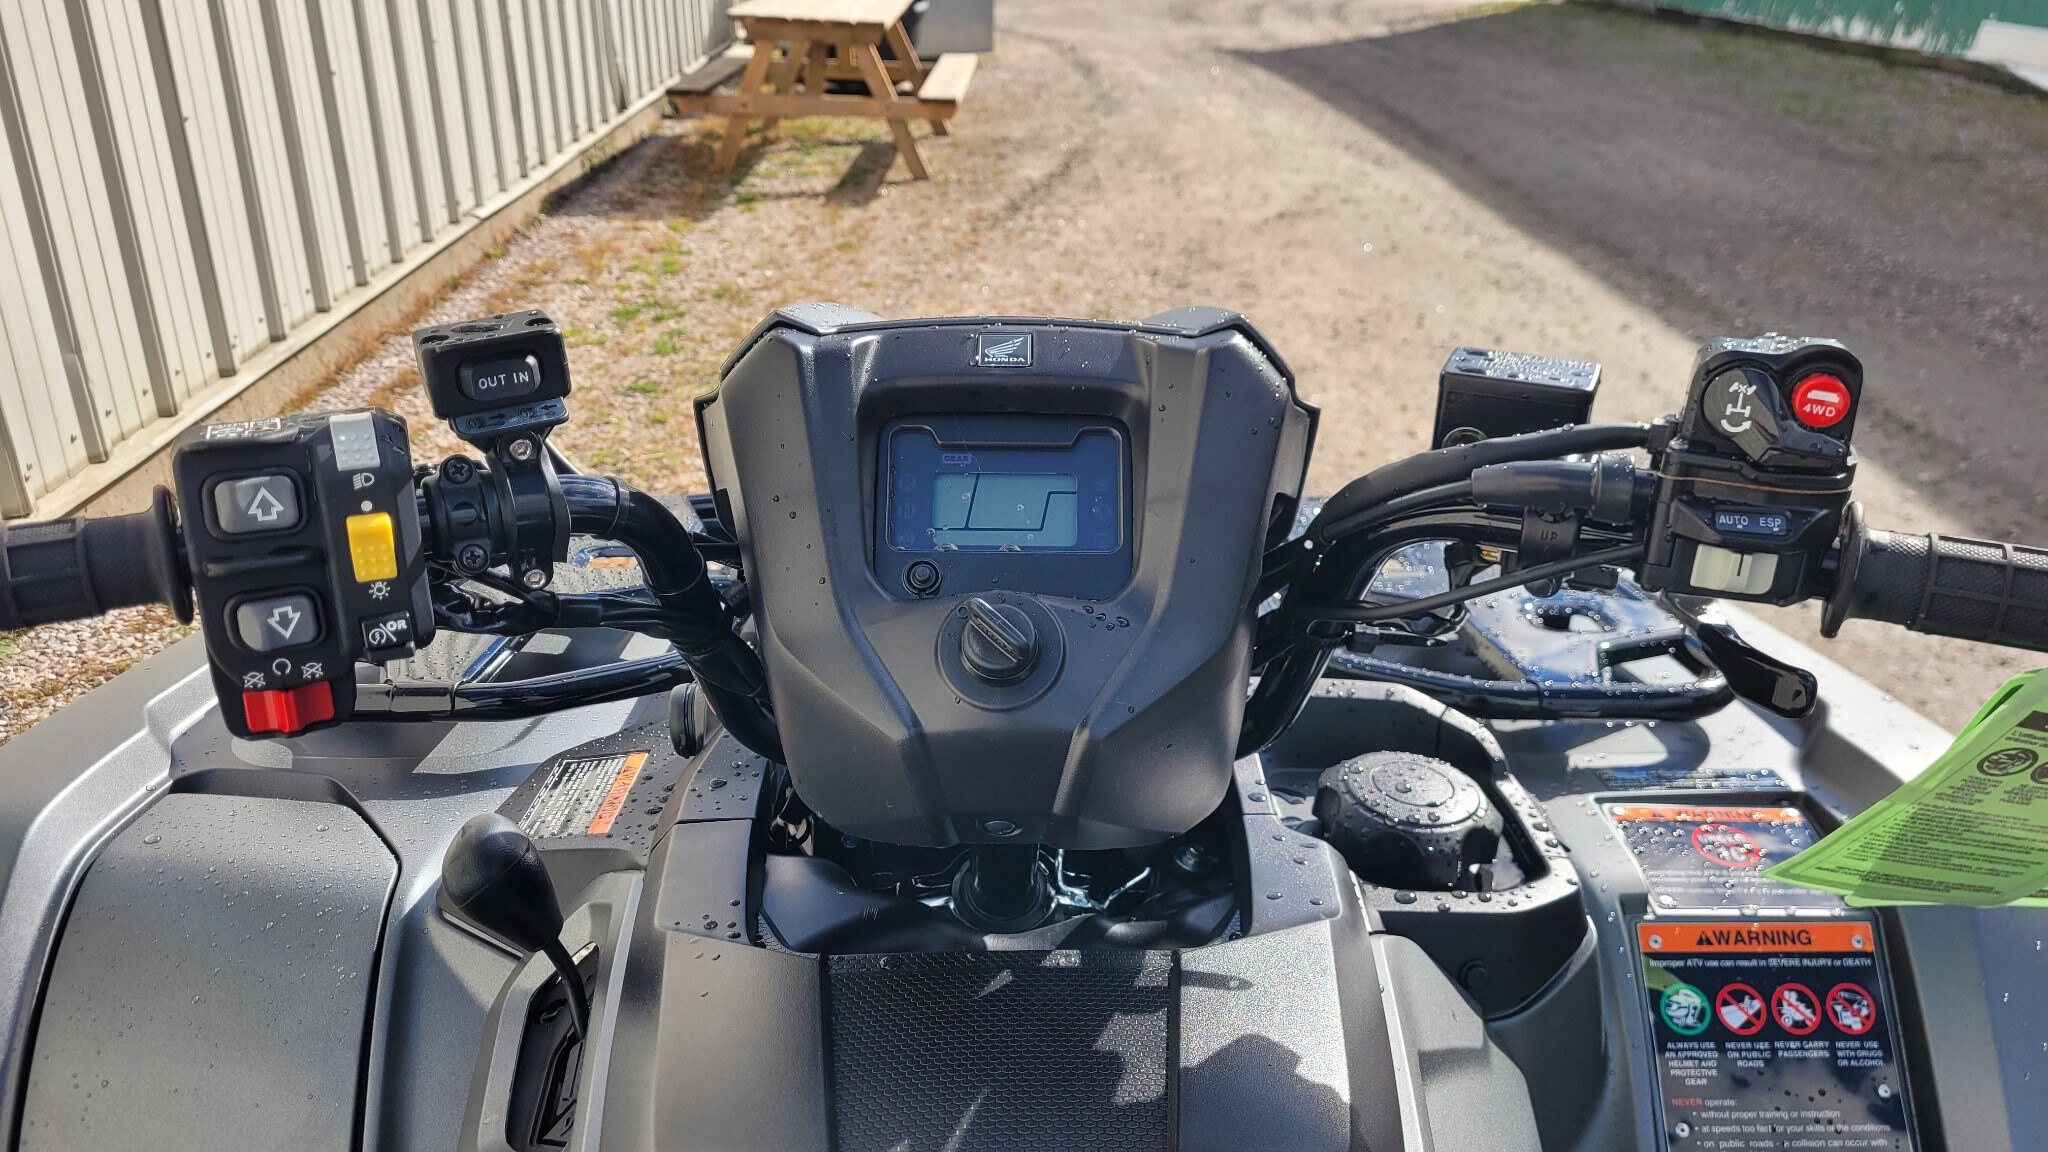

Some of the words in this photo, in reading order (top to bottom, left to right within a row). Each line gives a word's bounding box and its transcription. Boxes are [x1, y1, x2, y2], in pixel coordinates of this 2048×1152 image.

[478, 373, 506, 389] OUT
[513, 371, 529, 384] IN
[1803, 403, 1836, 417] 4WD
[1719, 514, 1749, 526] AUTO
[1759, 517, 1782, 528] ESP
[1541, 529, 1558, 541] UP
[386, 619, 407, 631] OR
[1713, 930, 1813, 946] WARNING
[1687, 959, 1703, 967] ATV
[1777, 1050, 1830, 1058] PASSENGERS
[1670, 1069, 1718, 1077] PROTECTIVE
[1685, 1078, 1707, 1086] GEAR
[1671, 1098, 1702, 1106] NEVER
[1700, 1110, 1730, 1119] without
[1731, 1111, 1758, 1120] proper
[1758, 1111, 1788, 1119] training
[1800, 1110, 1840, 1118] instruction
[1701, 1125, 1710, 1133] at
[1711, 1124, 1741, 1134] speeds
[1742, 1124, 1755, 1132] too
[1786, 1125, 1804, 1134] your
[1805, 1124, 1826, 1132] skills
[1850, 1123, 1891, 1132] conditions
[1703, 1140, 1714, 1148] on
[1719, 1140, 1745, 1149] public
[1749, 1140, 1774, 1148] roads
[1791, 1140, 1826, 1148] collision
[1827, 1140, 1843, 1148] can
[1844, 1140, 1869, 1148] occur
[1869, 1139, 1888, 1148] with
